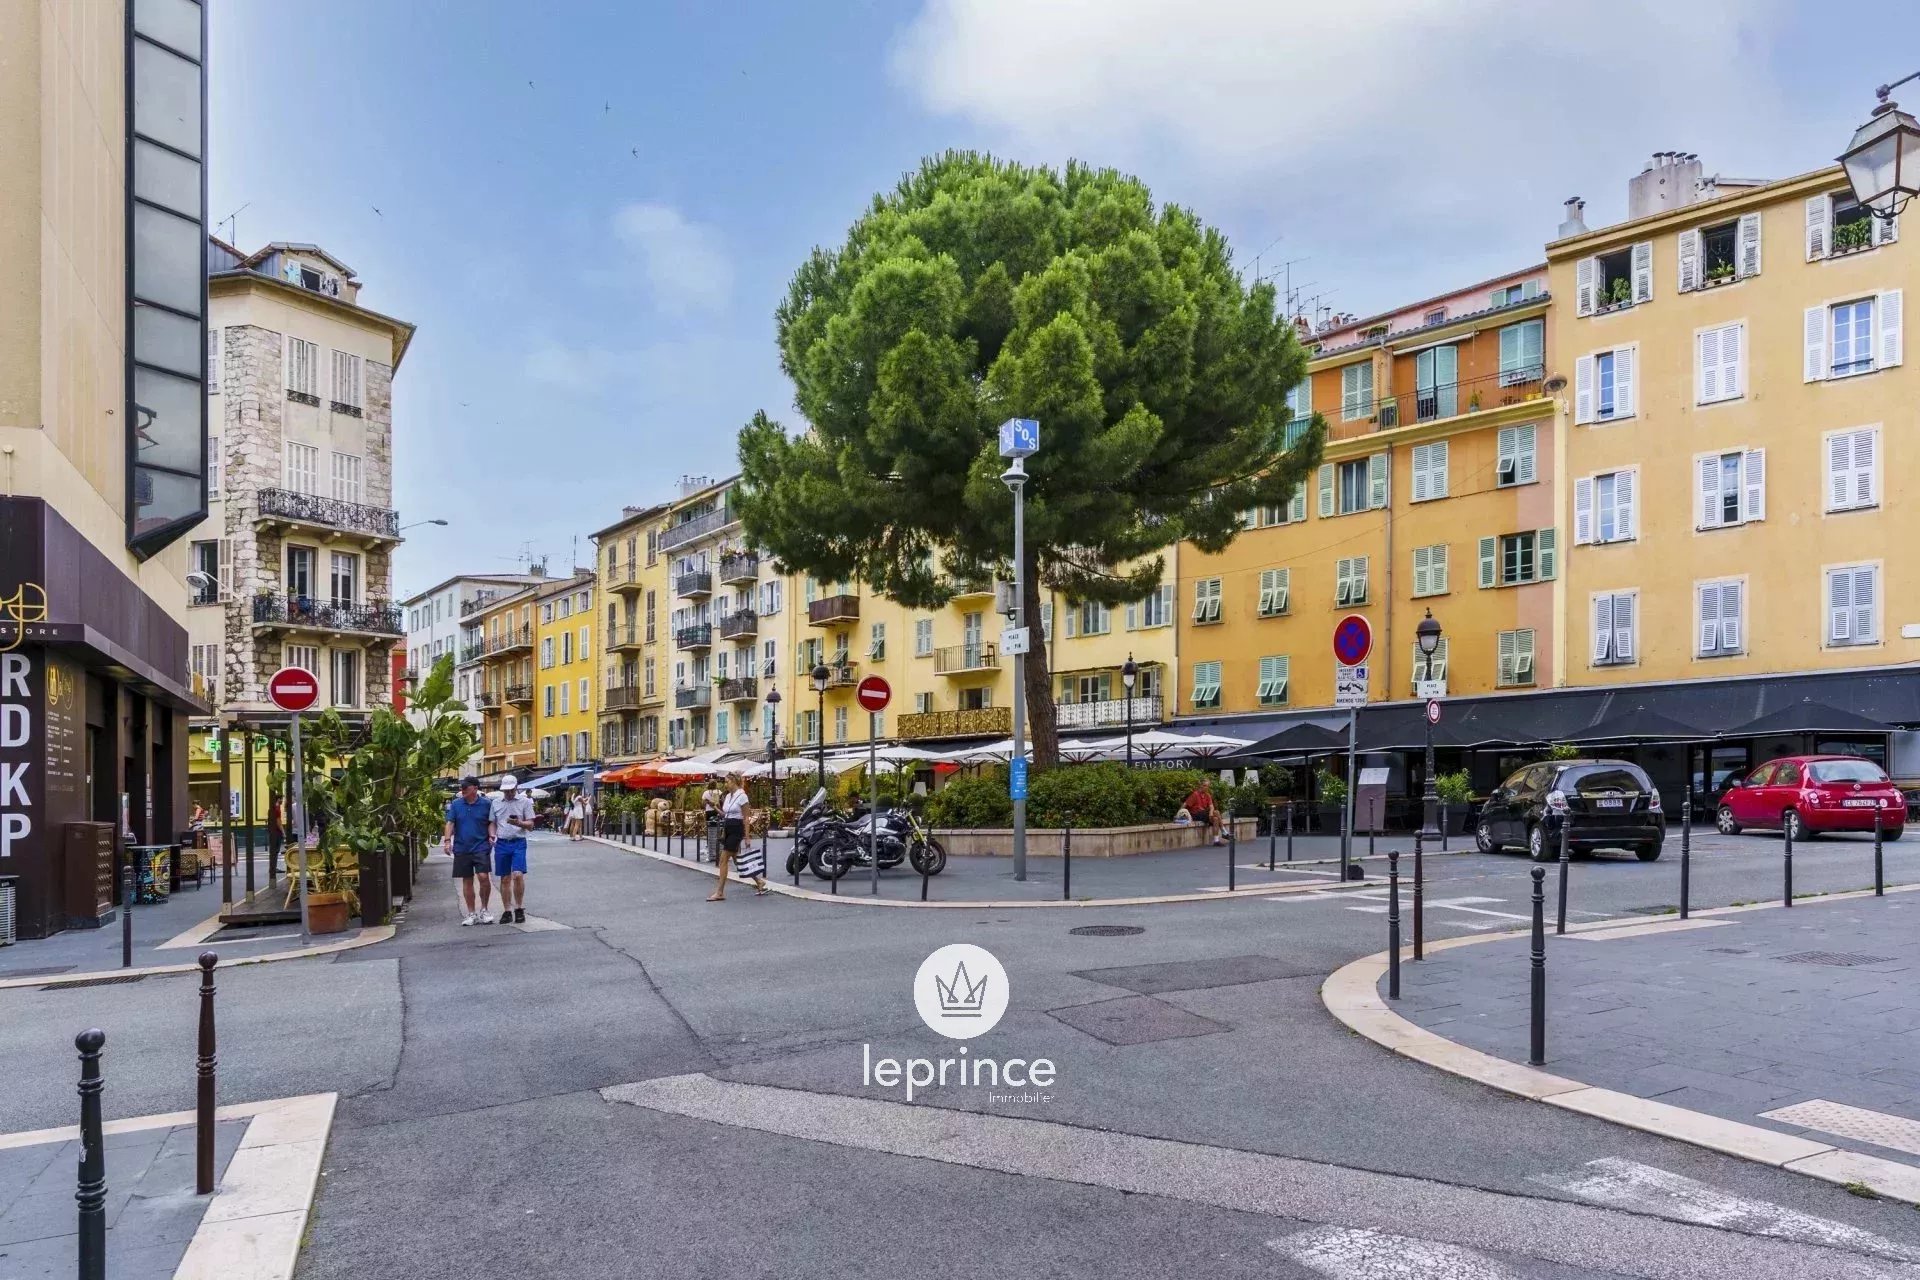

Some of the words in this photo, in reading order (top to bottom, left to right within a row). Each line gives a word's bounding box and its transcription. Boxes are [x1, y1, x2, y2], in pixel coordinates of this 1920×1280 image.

[1015, 420, 1036, 450] SOS
[1, 627, 58, 636] STORE
[1135, 760, 1192, 769] FACTORY
